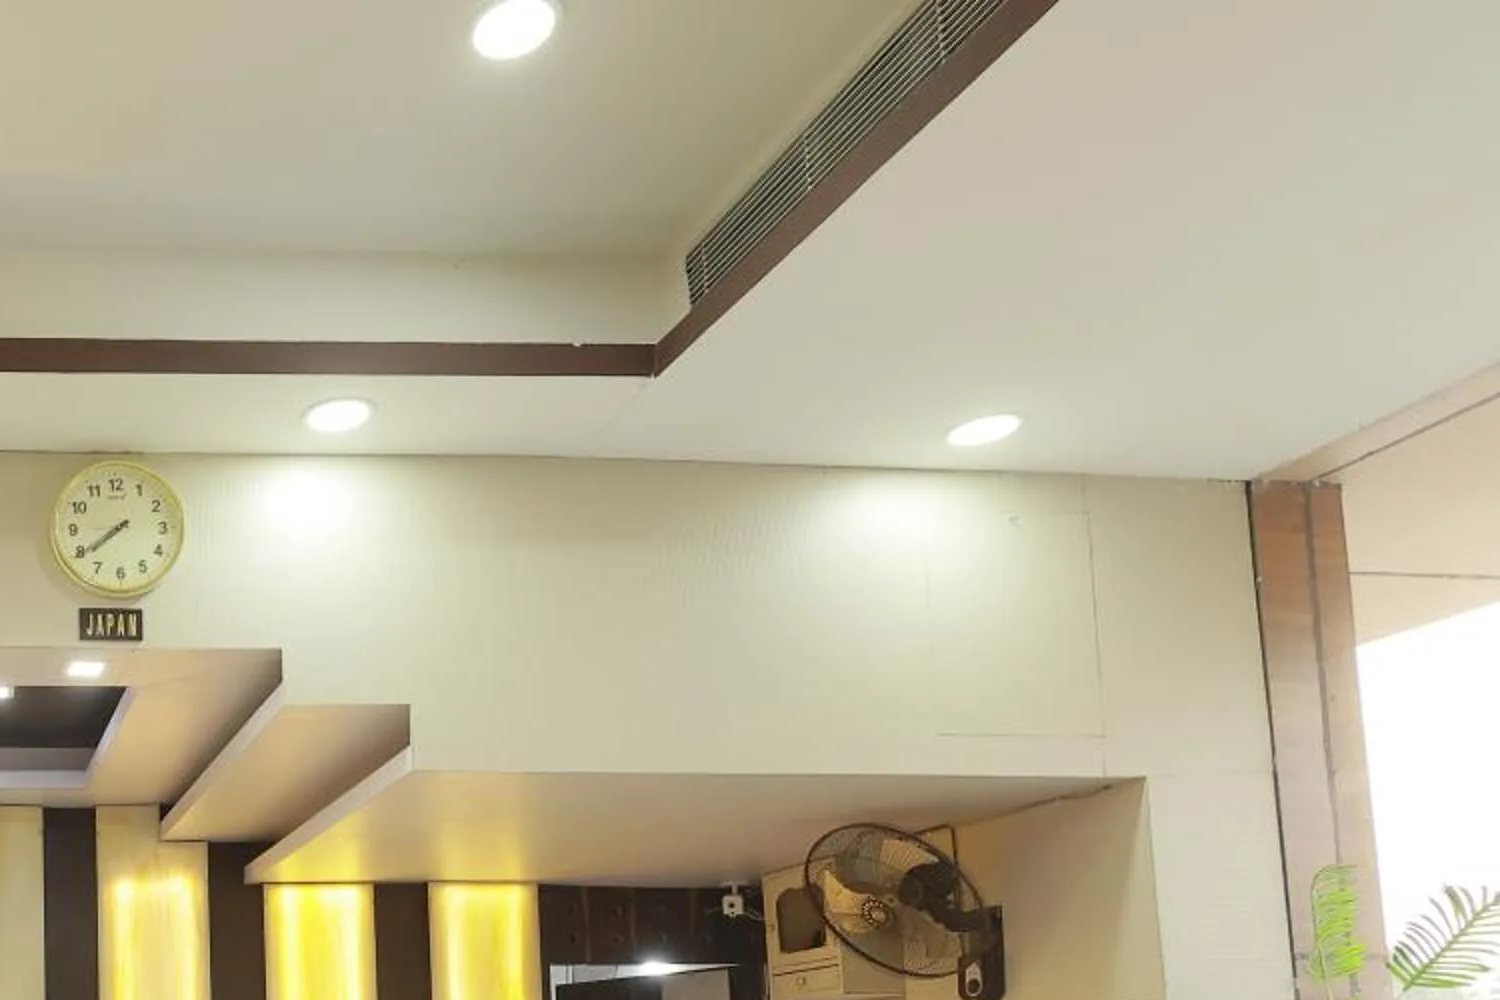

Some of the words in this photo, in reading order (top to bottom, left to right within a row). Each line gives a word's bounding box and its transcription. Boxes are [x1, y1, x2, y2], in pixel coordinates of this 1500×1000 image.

[88, 484, 101, 497] 11
[108, 478, 124, 492] 12
[136, 484, 142, 496] 1
[72, 501, 87, 514] 10
[152, 499, 161, 513] 2
[68, 523, 78, 537] 9
[158, 521, 168, 535] 3
[75, 545, 85, 558] 8
[153, 543, 163, 557] 4
[93, 561, 102, 574] 7
[138, 560, 148, 573] 5
[116, 567, 125, 580] 6
[86, 613, 136, 637] JAPAN
